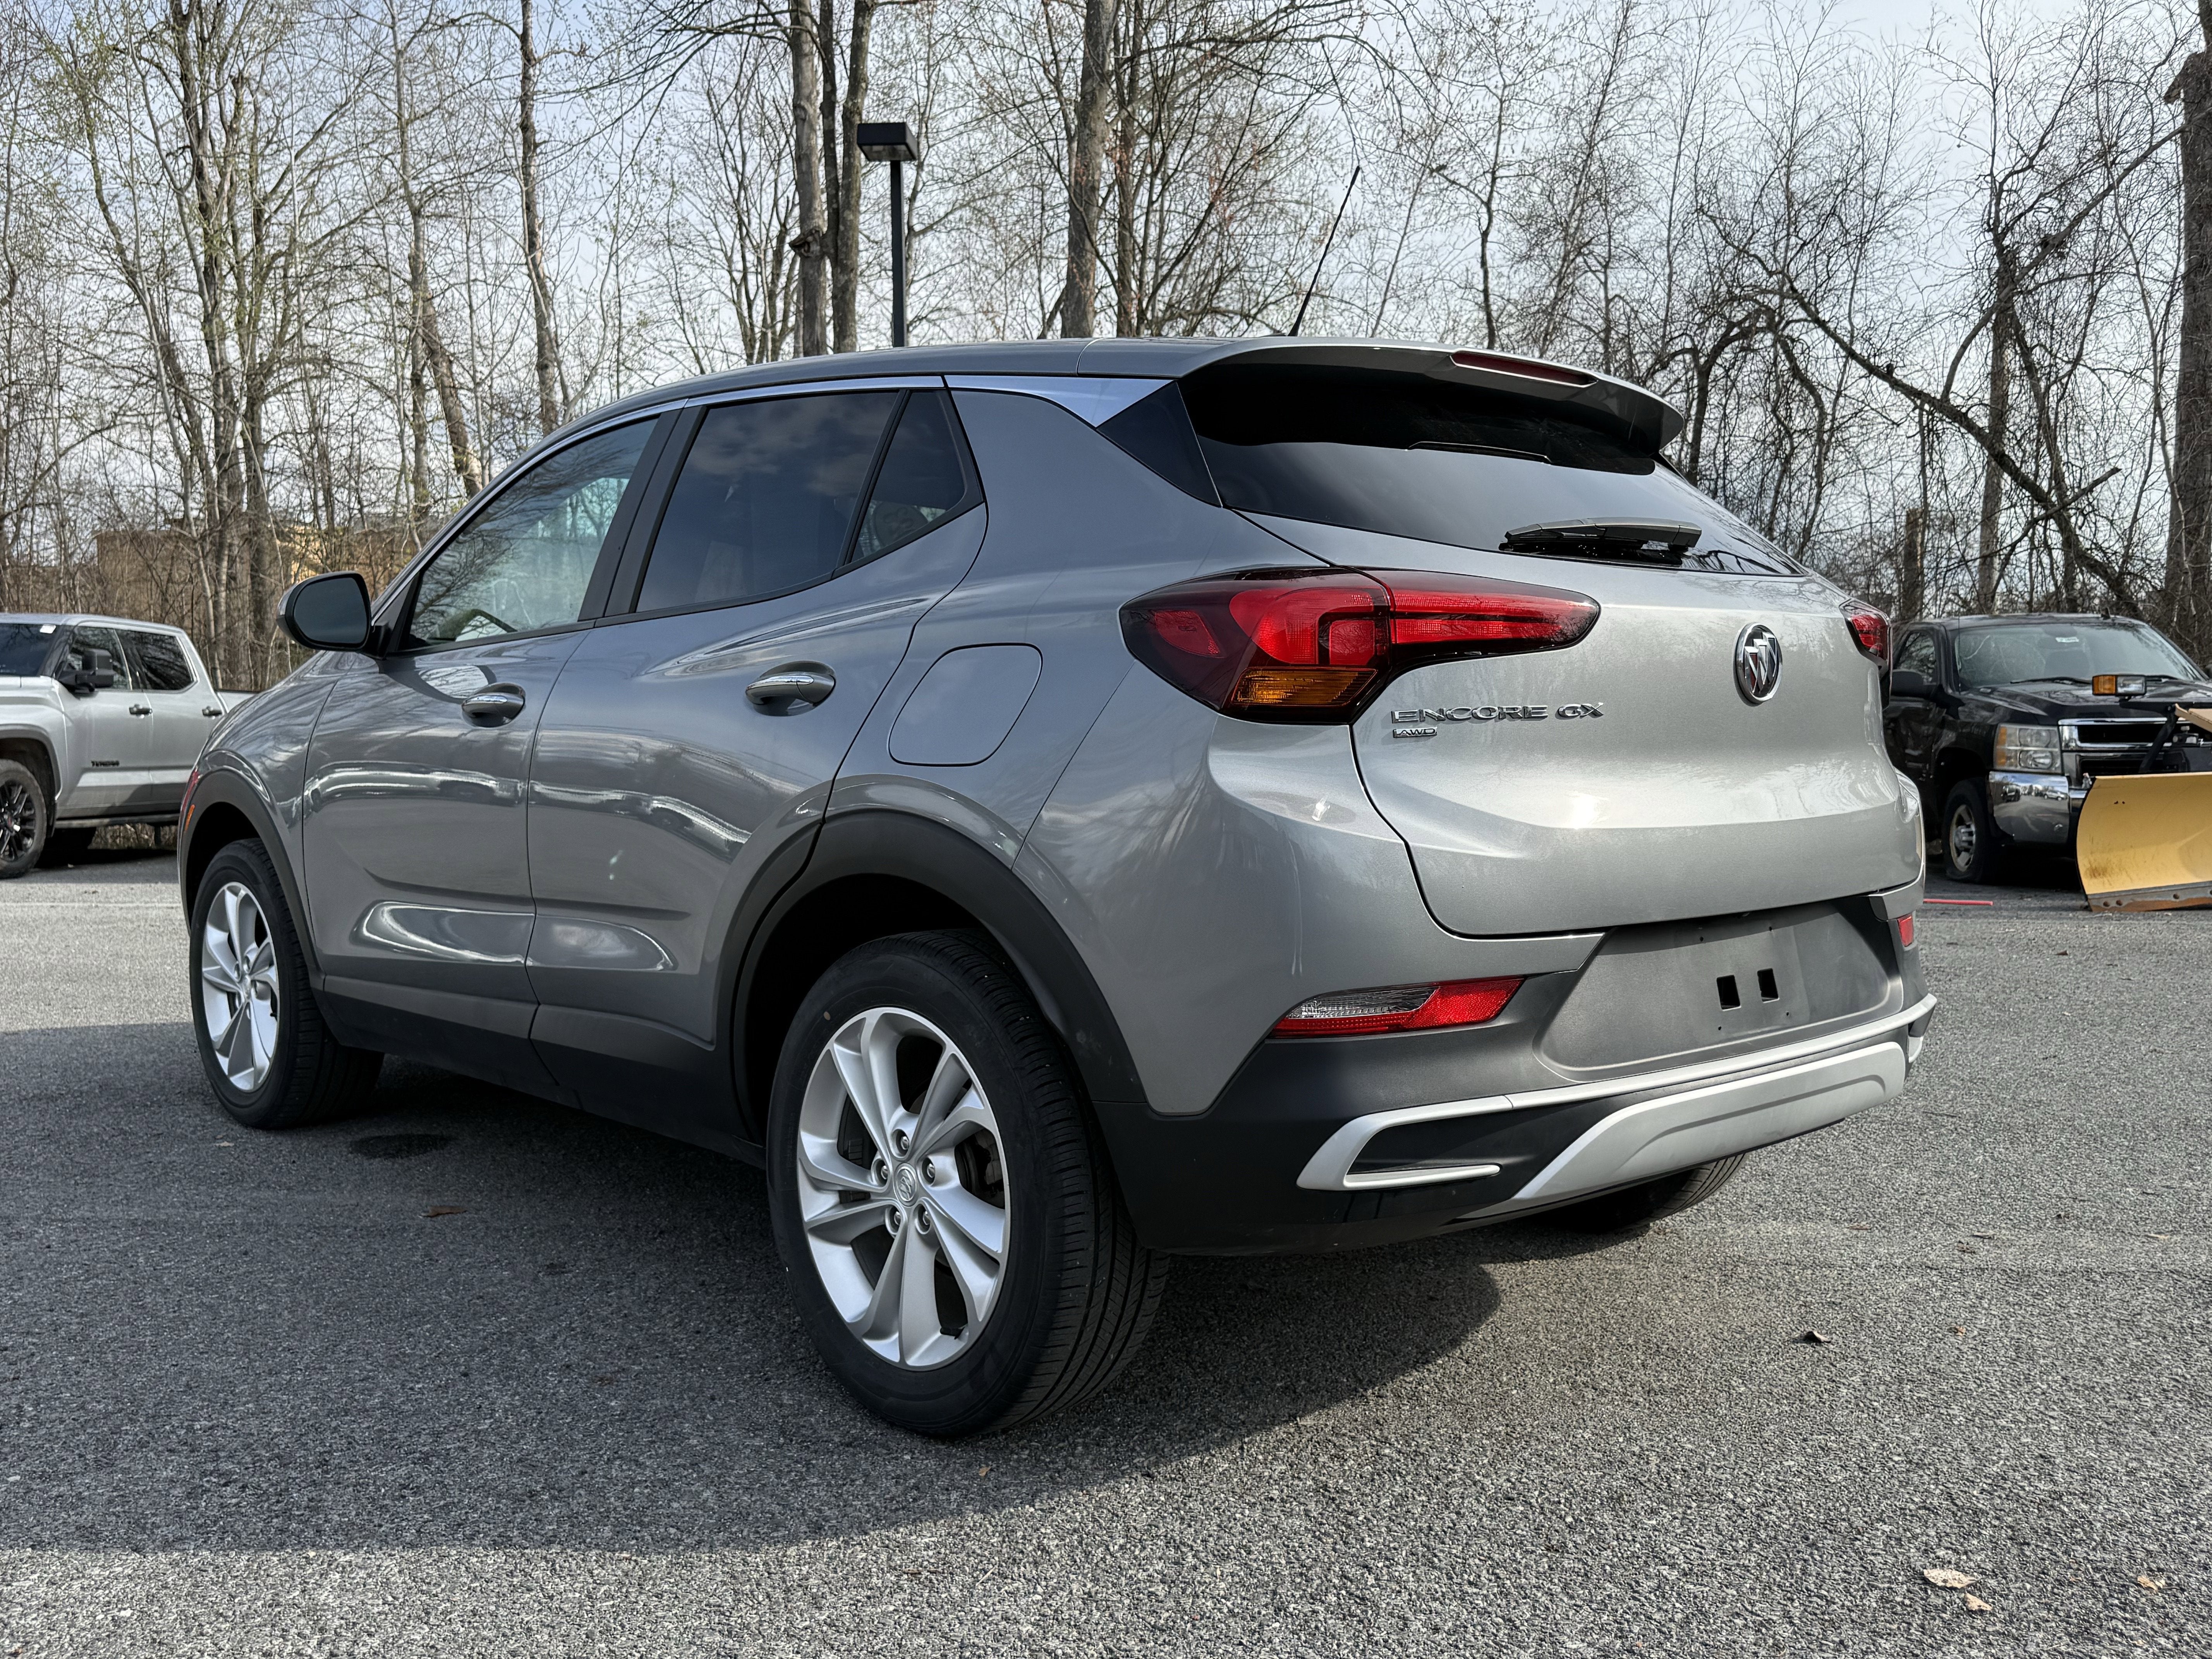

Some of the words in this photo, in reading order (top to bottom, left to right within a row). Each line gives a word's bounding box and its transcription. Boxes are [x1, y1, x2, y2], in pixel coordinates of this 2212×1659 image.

[1391, 704, 1549, 724] ENCORE
[1556, 702, 1604, 719] GX
[1397, 727, 1436, 737] AWD
